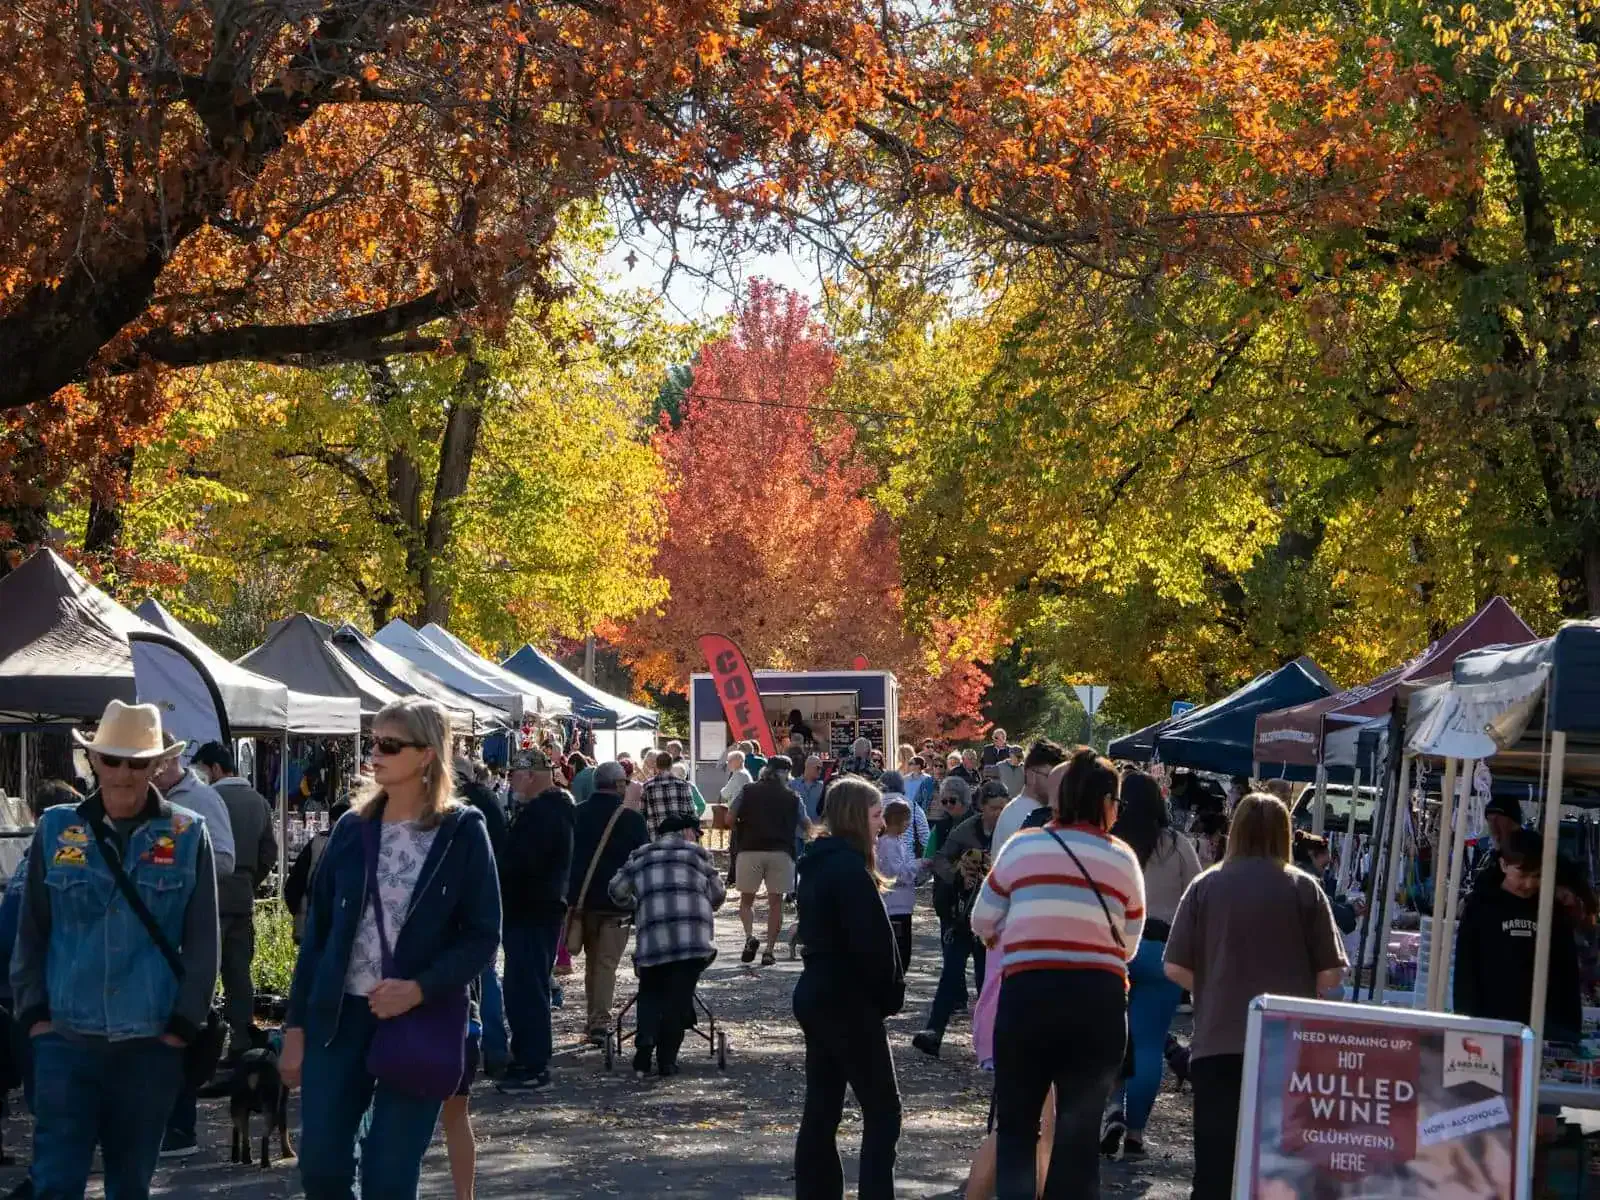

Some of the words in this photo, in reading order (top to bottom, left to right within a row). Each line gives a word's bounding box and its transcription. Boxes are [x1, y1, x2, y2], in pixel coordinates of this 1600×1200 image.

[1292, 1031, 1326, 1043] NEED
[1328, 1033, 1388, 1049] WARMING
[1390, 1040, 1412, 1050] UP?
[1338, 1050, 1366, 1070] HOT
[1289, 1071, 1414, 1102] MULLED
[1310, 1097, 1391, 1125] WINE
[1302, 1128, 1395, 1150] (GLÜHWEIN)
[1330, 1151, 1367, 1172] HERE
